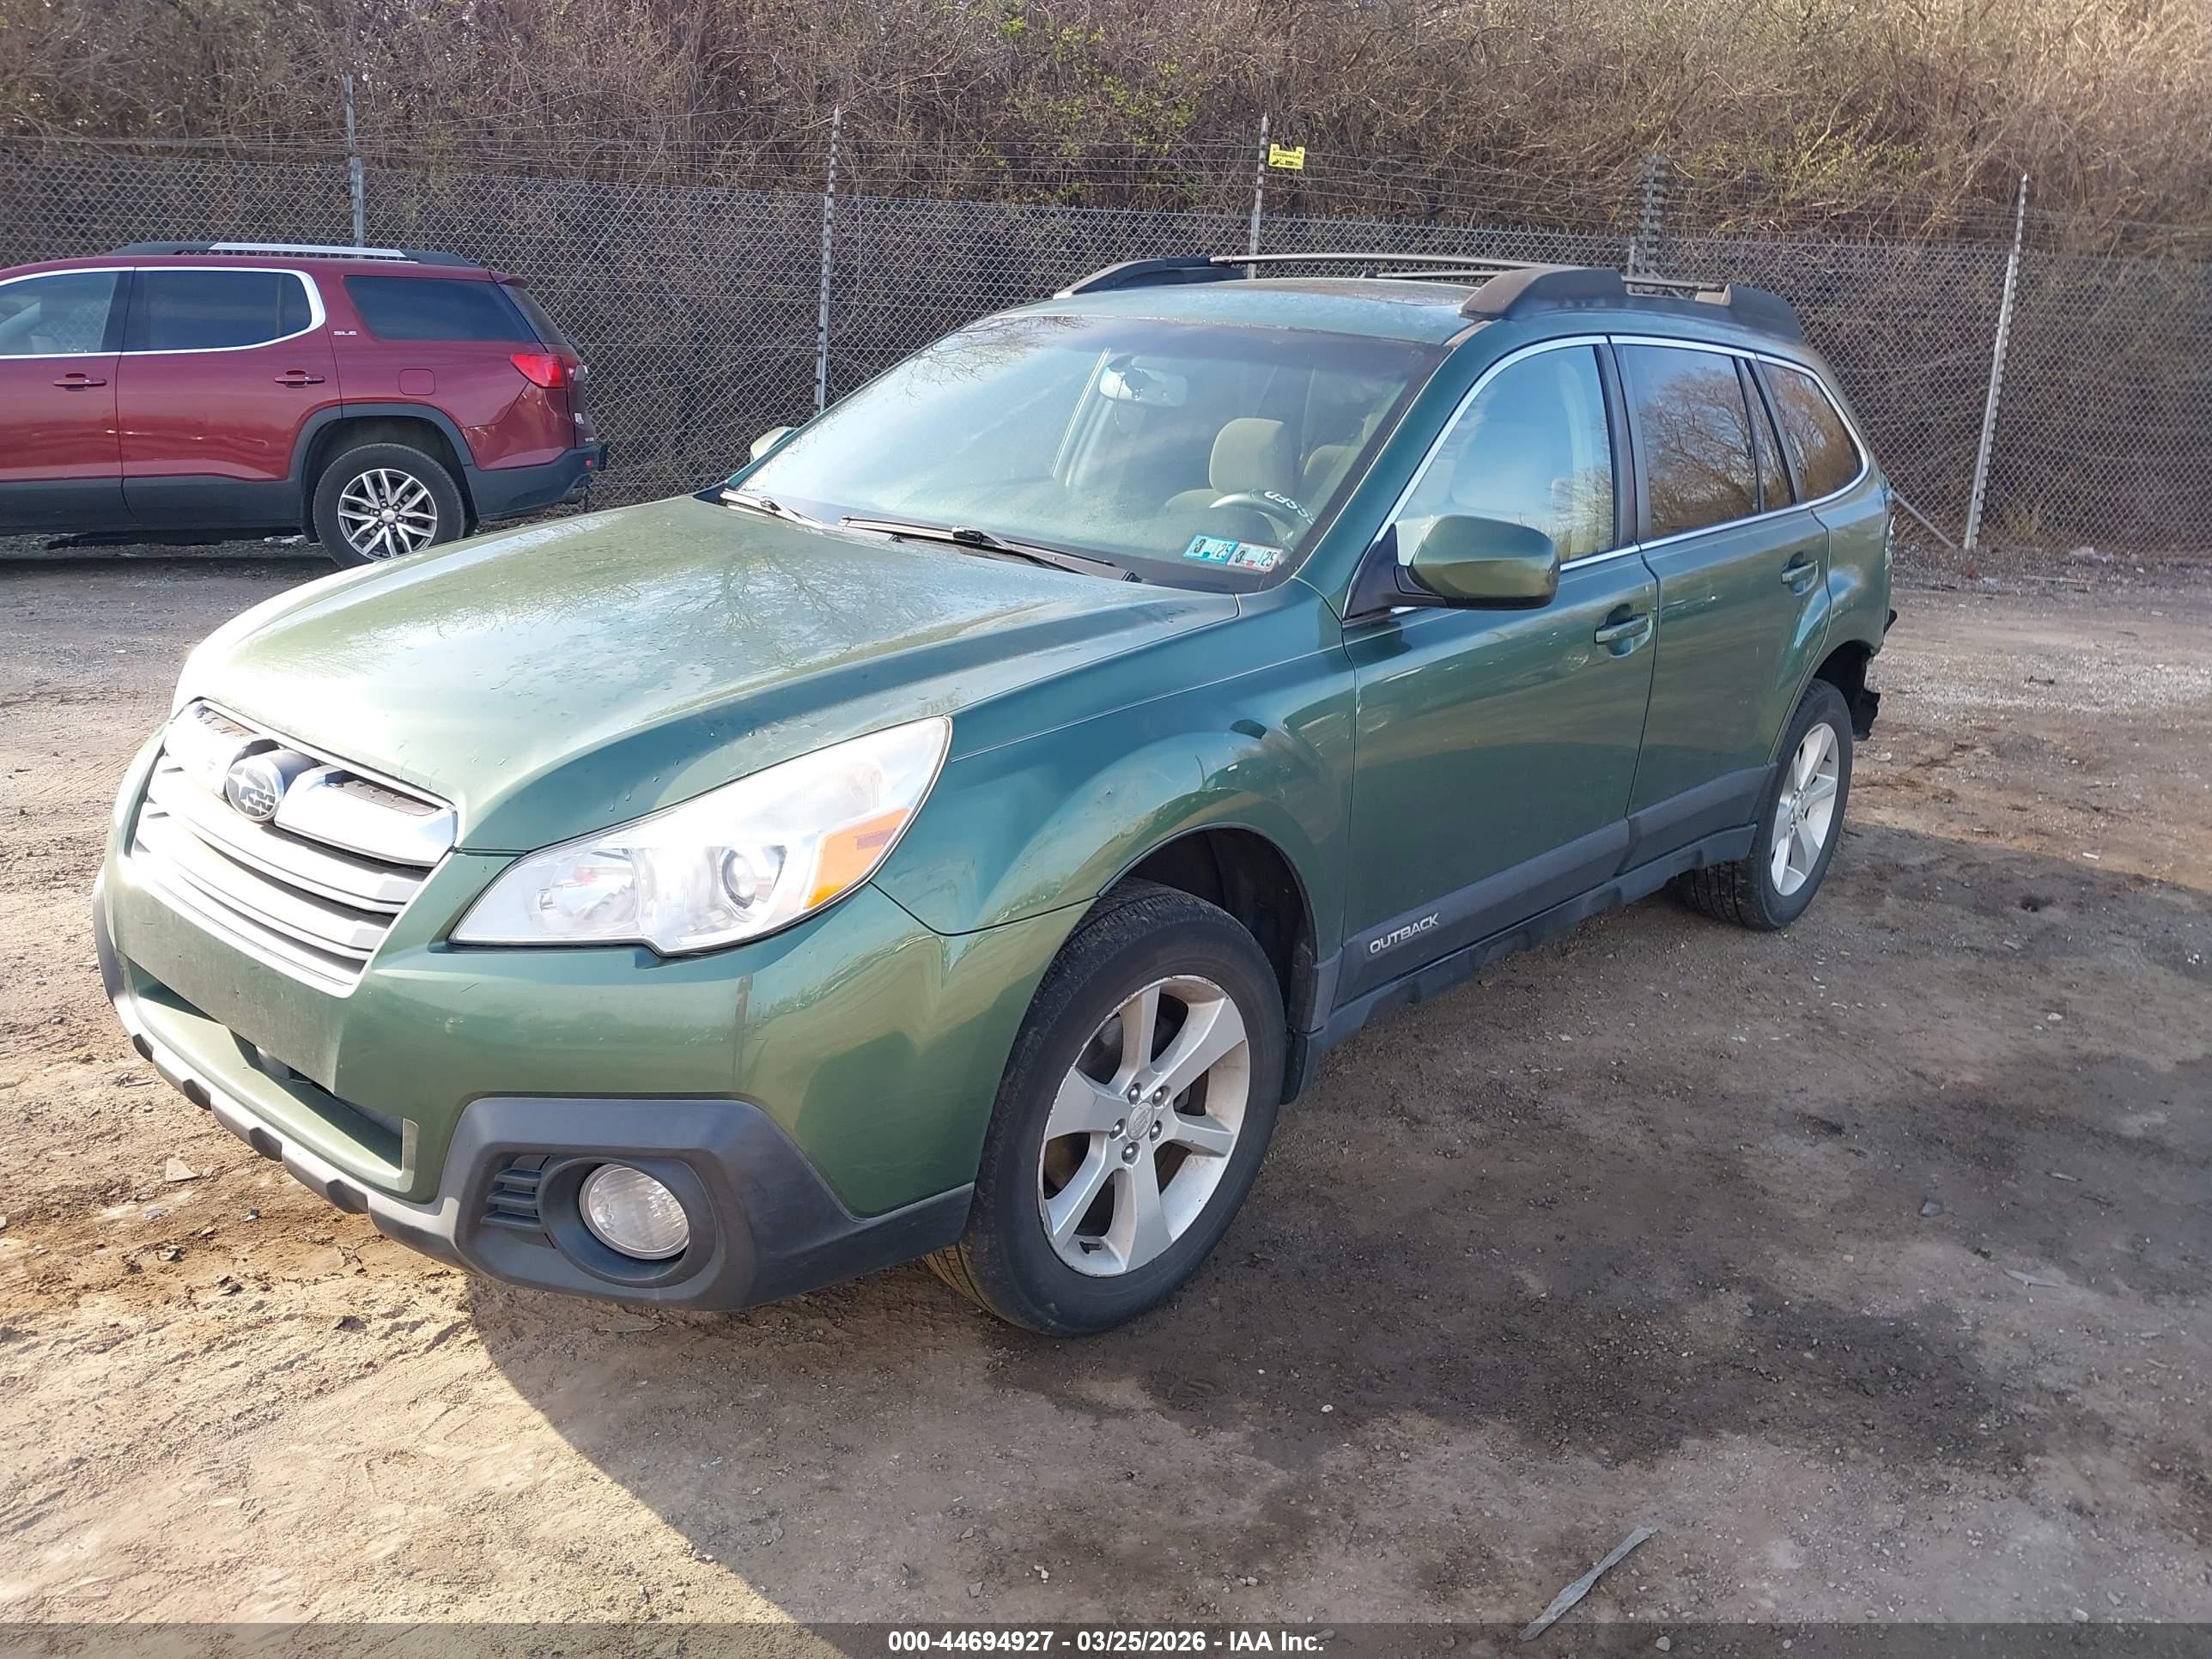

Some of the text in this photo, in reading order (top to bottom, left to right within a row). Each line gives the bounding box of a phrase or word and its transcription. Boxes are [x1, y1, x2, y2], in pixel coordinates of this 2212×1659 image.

[1194, 538, 1233, 559] 3 25
[1235, 550, 1278, 567] 3 25
[1370, 912, 1439, 954] OUTBACK
